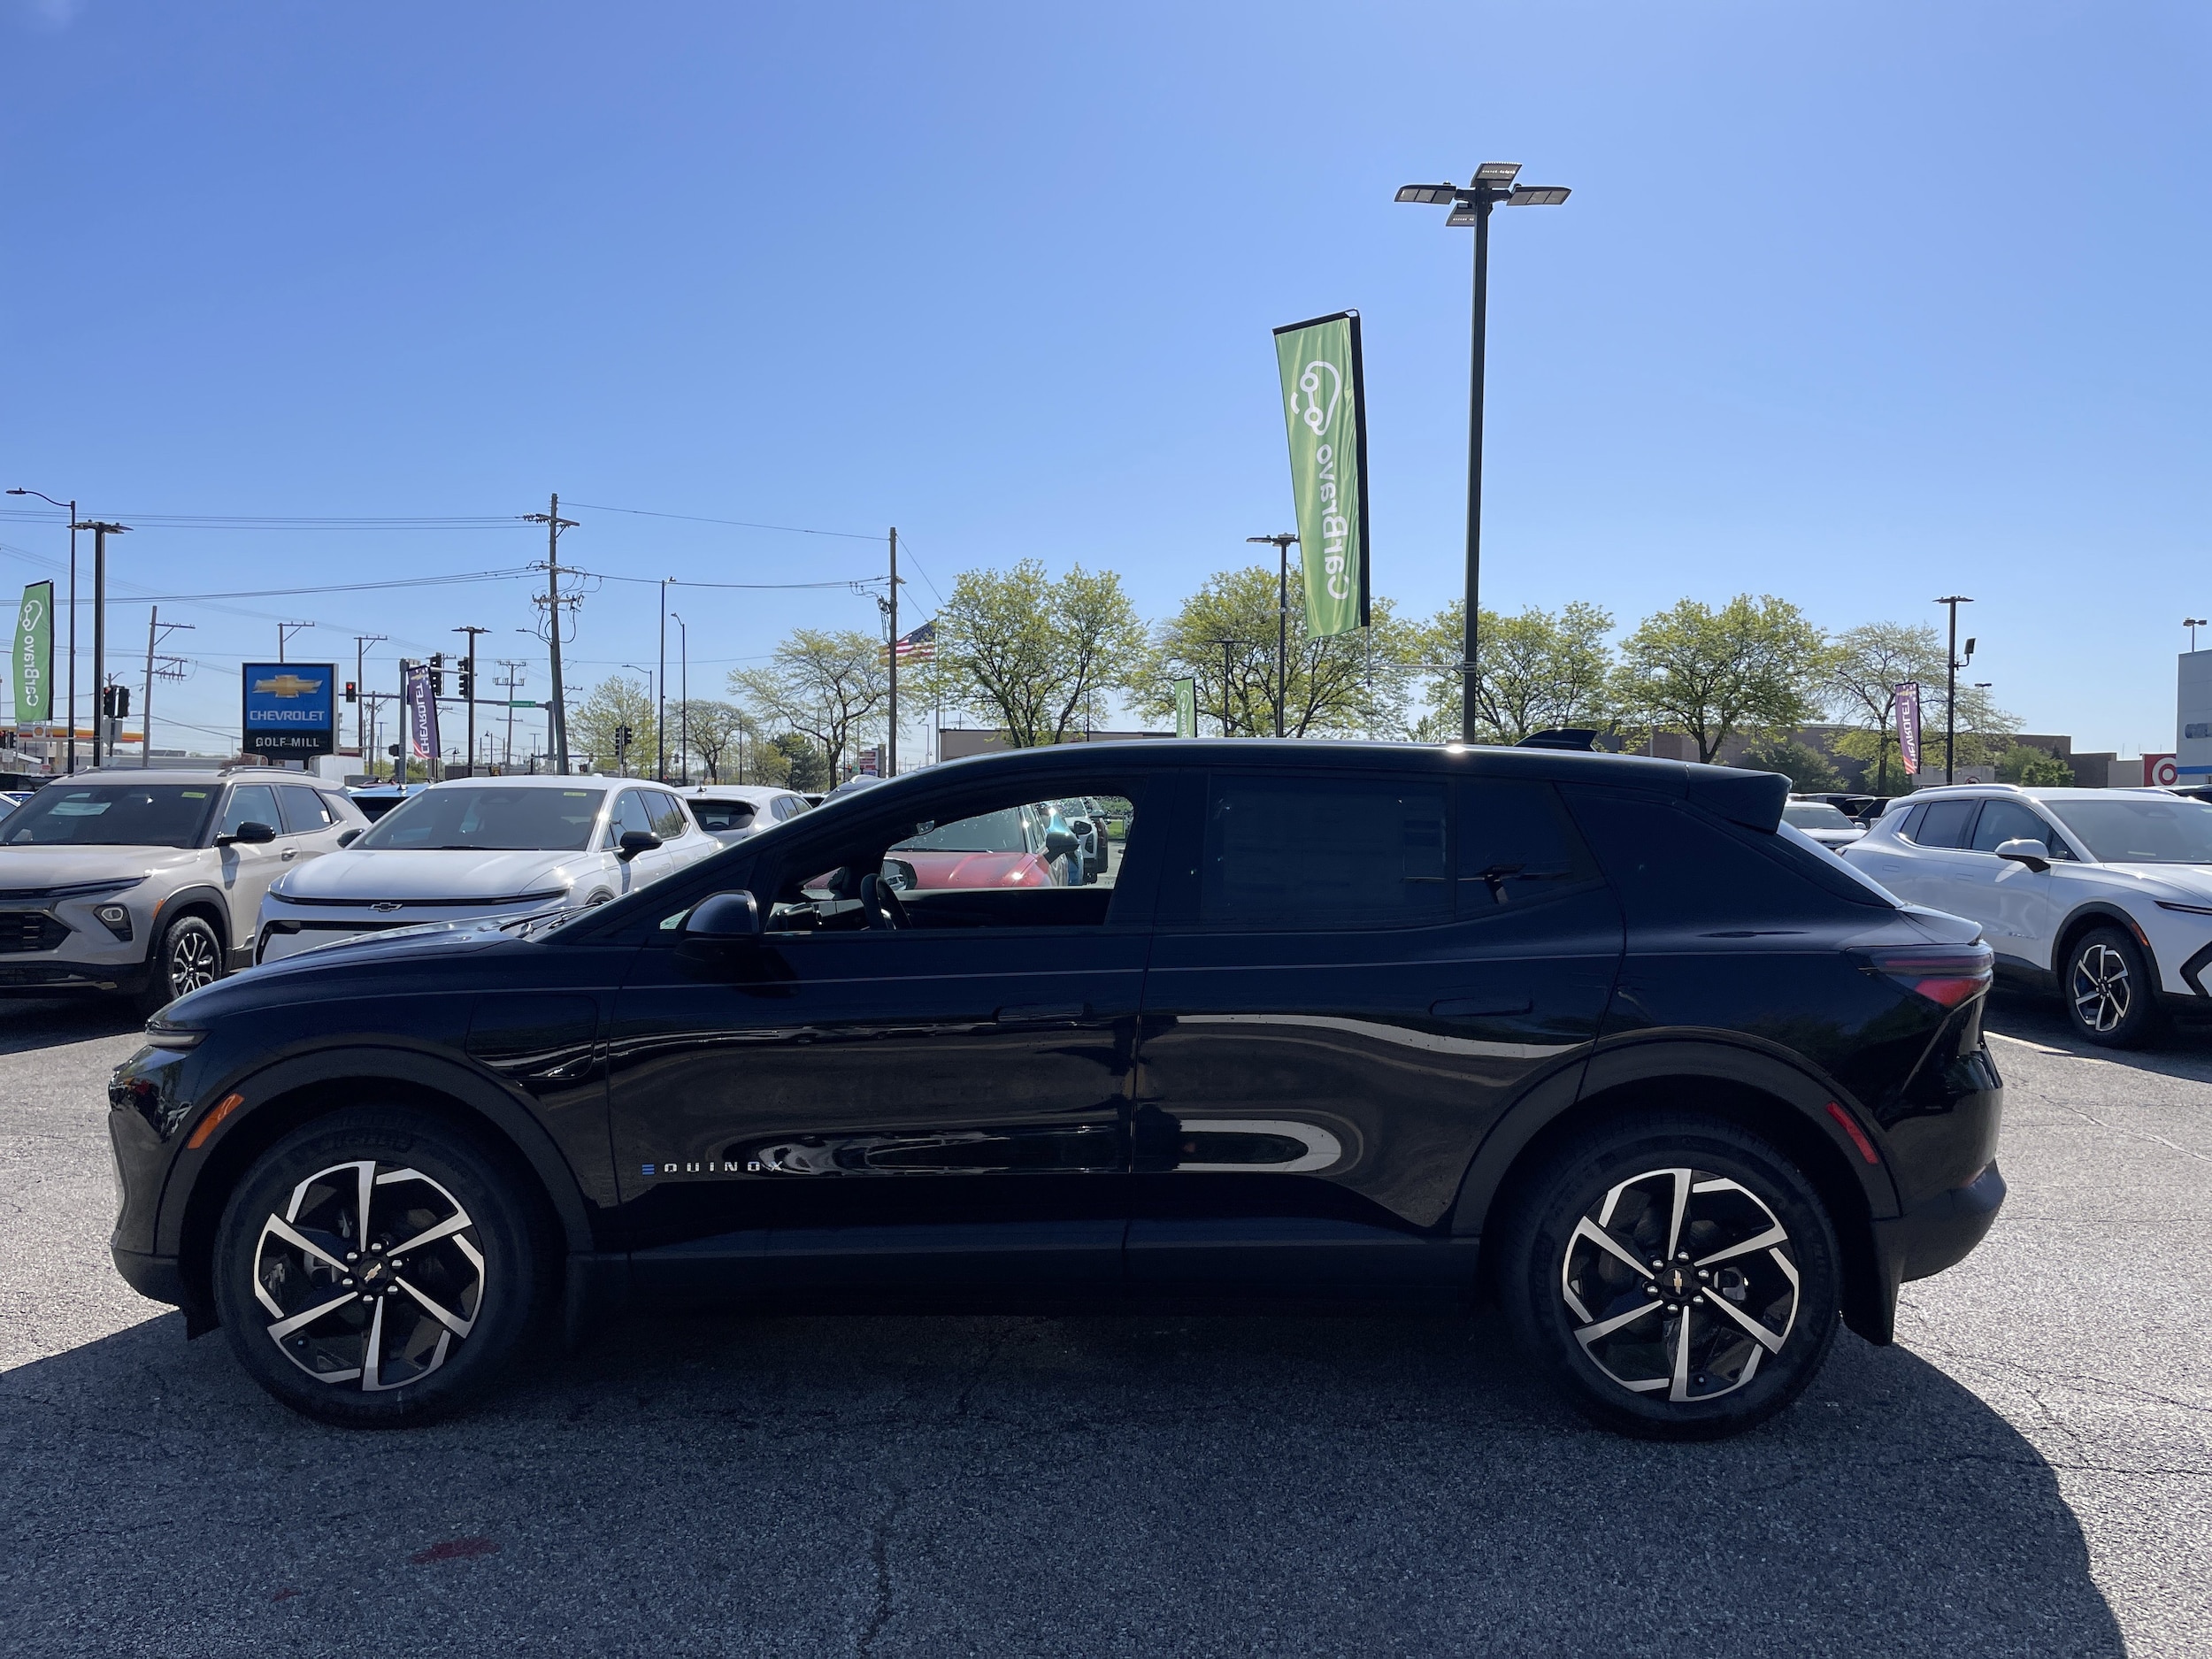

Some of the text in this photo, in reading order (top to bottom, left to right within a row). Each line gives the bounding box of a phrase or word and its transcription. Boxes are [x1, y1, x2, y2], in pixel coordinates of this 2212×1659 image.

[250, 710, 325, 721] CHEVROLET
[256, 737, 319, 748] GOLF MILL
